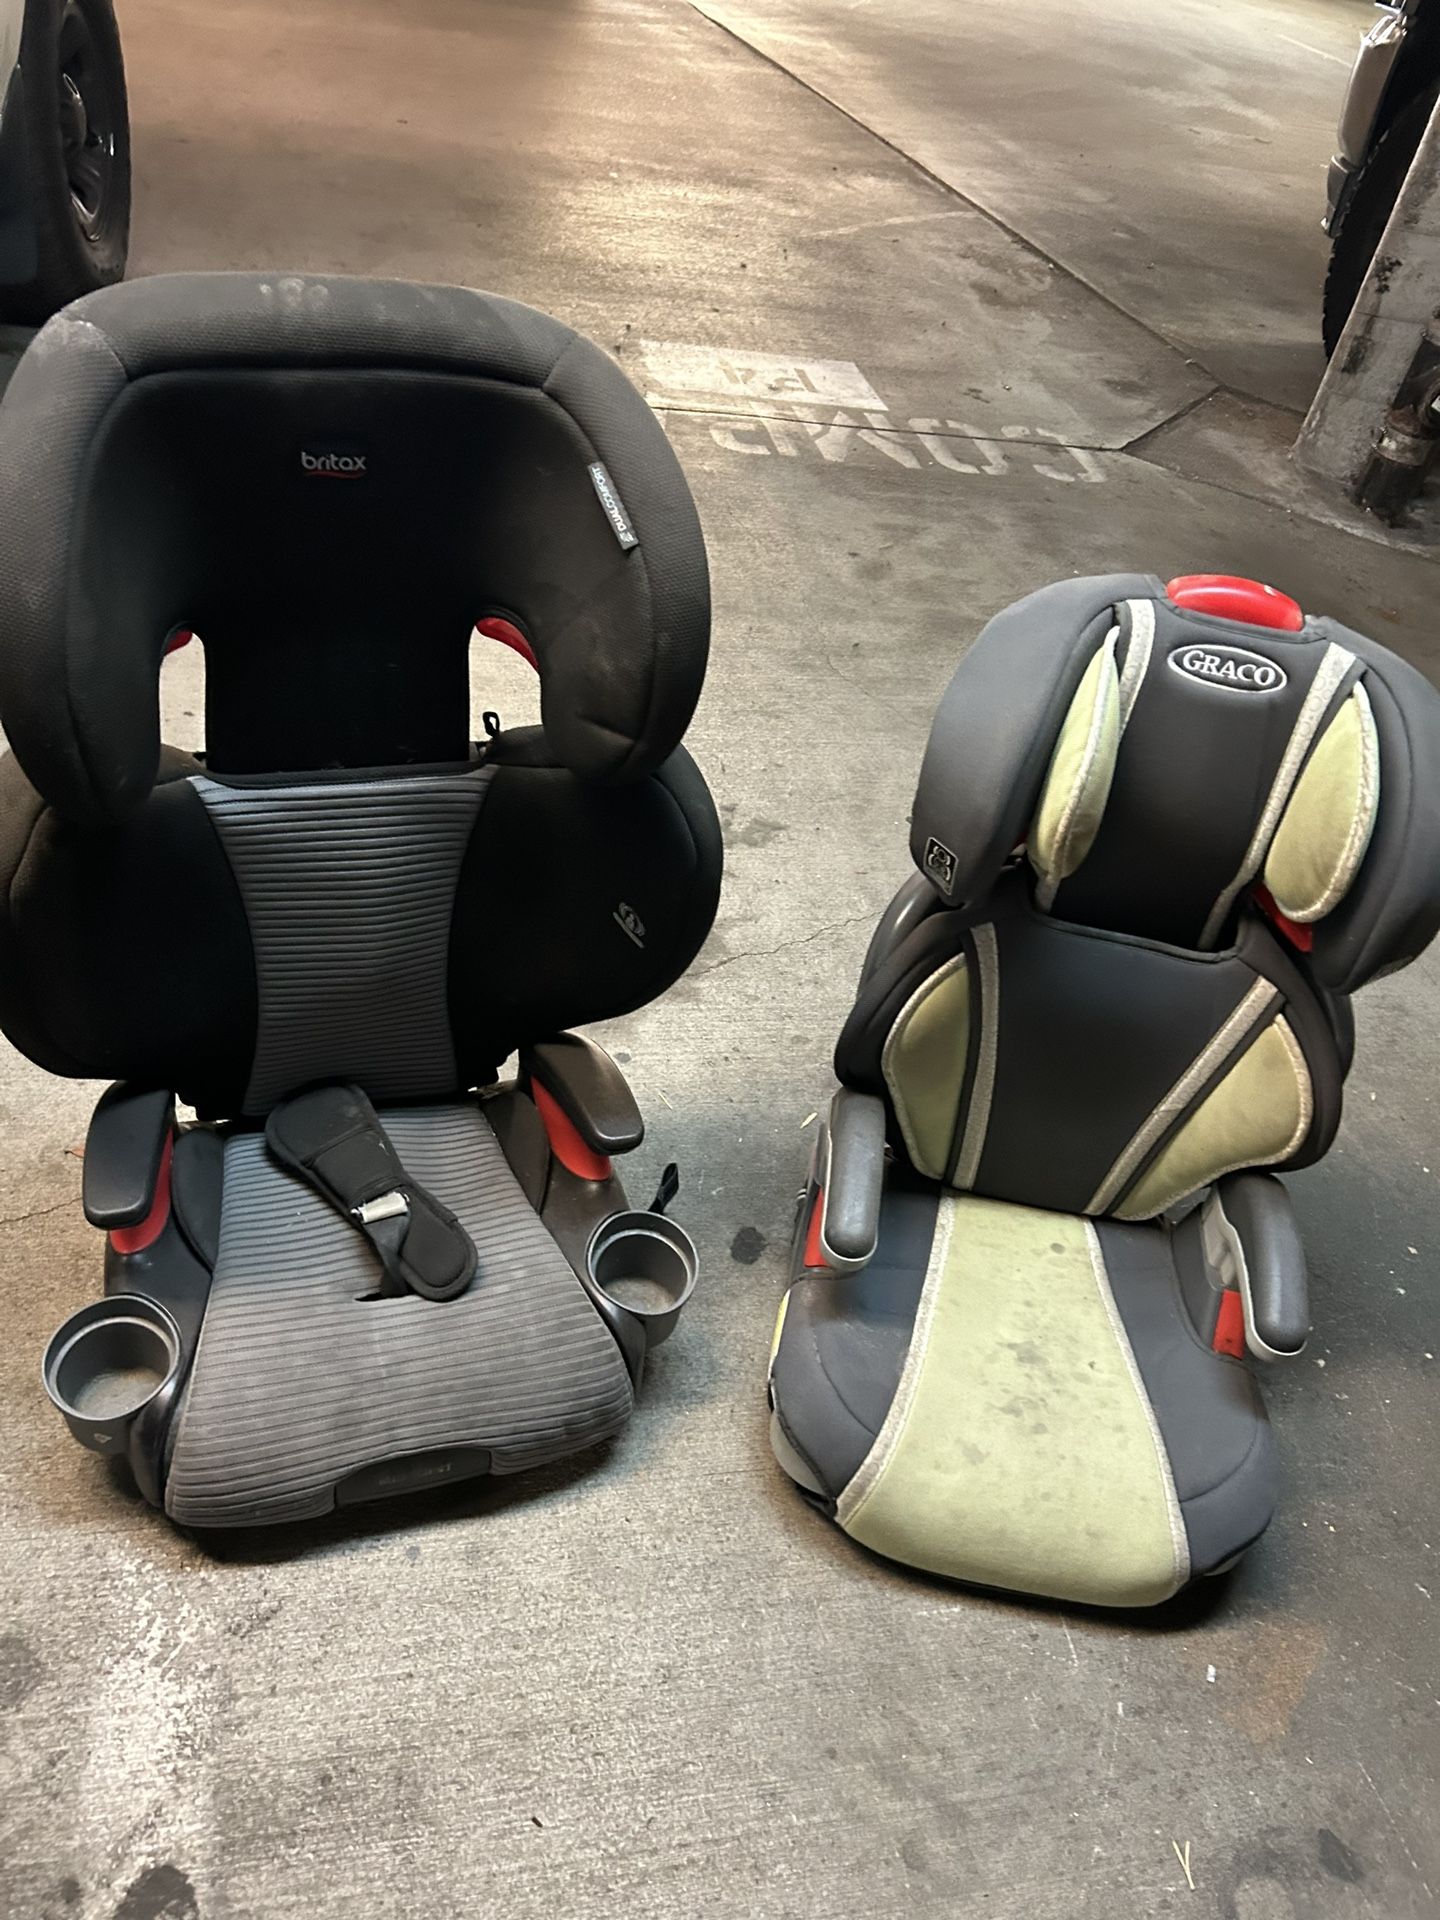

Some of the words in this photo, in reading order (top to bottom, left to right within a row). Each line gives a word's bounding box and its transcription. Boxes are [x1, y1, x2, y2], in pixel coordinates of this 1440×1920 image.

[301, 452, 366, 471] britax
[651, 400, 1107, 483] COMP
[592, 467, 627, 531] DUALCOMFORT
[1182, 650, 1276, 685] GRACO
